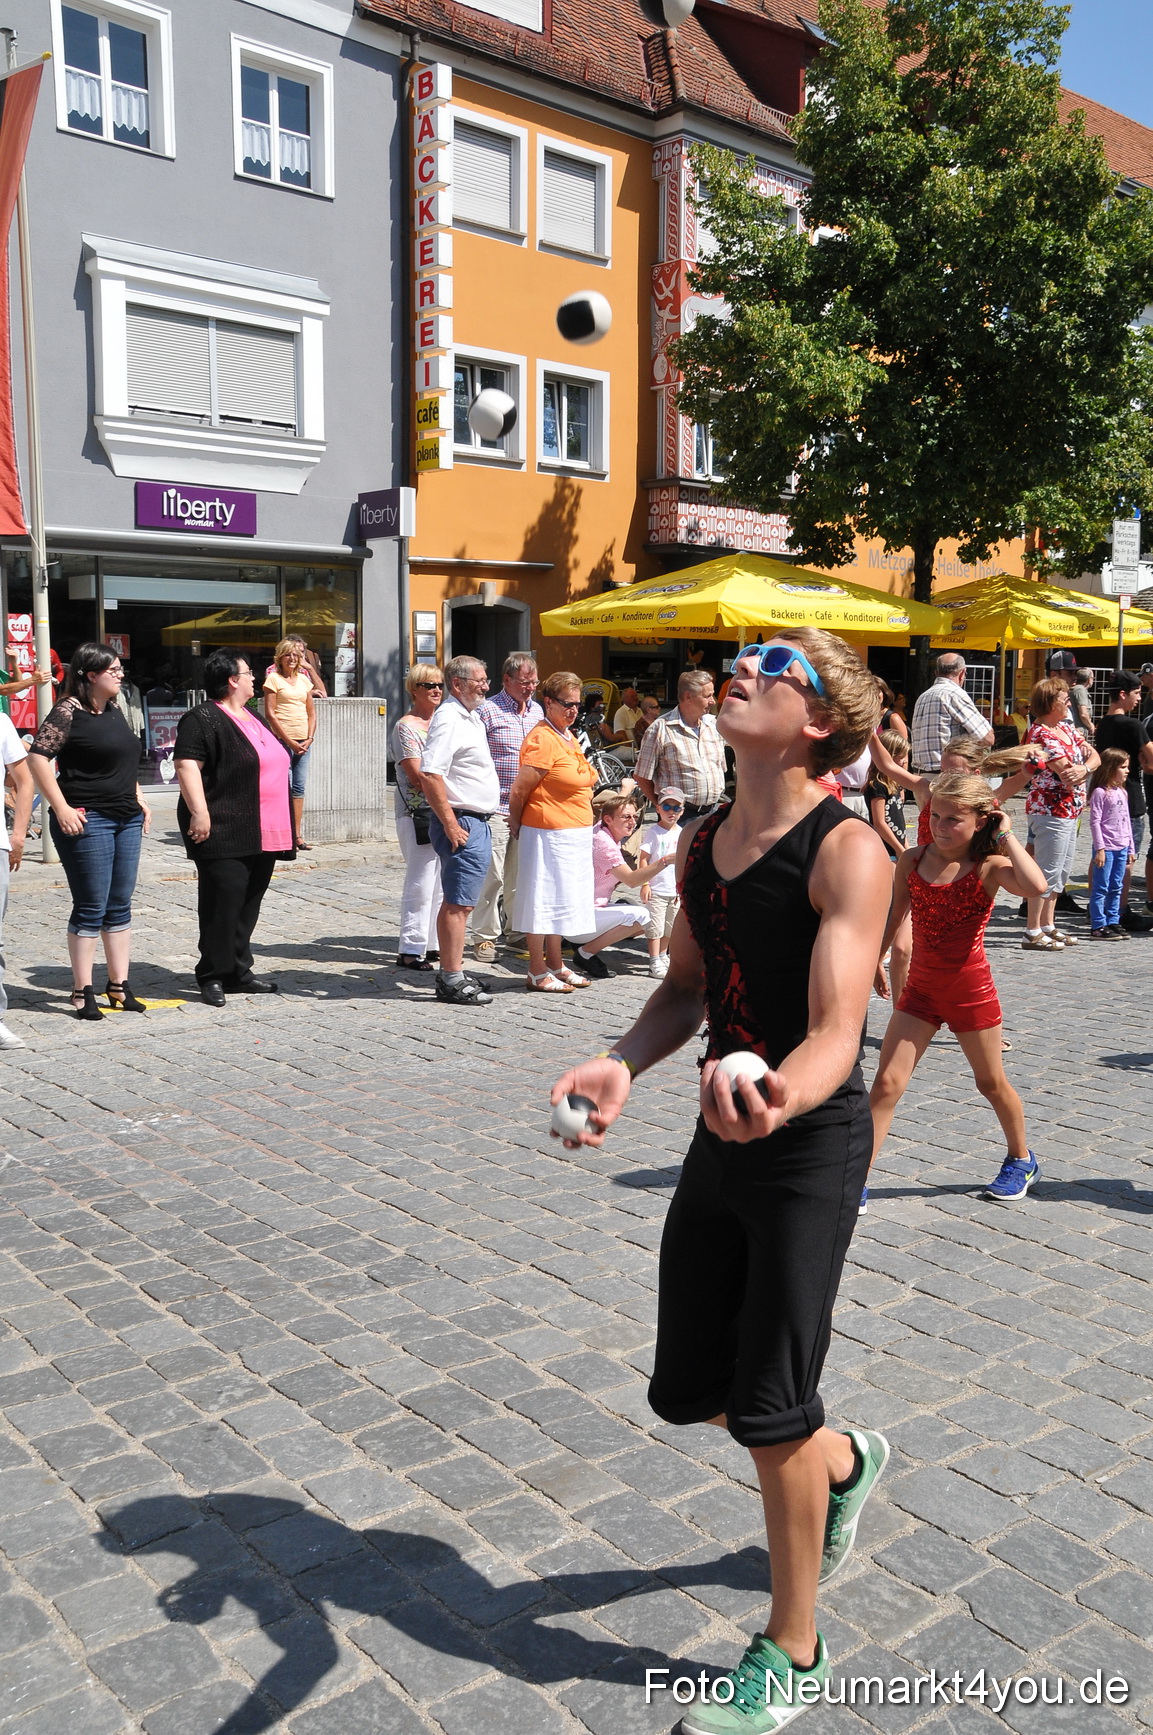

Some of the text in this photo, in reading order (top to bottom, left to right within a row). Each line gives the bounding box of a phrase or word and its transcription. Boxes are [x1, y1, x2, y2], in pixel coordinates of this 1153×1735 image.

[416, 69, 436, 388] BÄCKEREI
[416, 400, 440, 425] café
[416, 440, 440, 467] plank
[163, 488, 236, 527] liberty
[360, 503, 398, 527] liberty
[184, 517, 215, 528] woman
[570, 610, 655, 626] Bäckerei Café Konditorei
[771, 609, 883, 623] Bäckerei Café Konditorei
[11, 623, 28, 632] SALE
[1048, 621, 1134, 634] Bäckerei Café Kondorei
